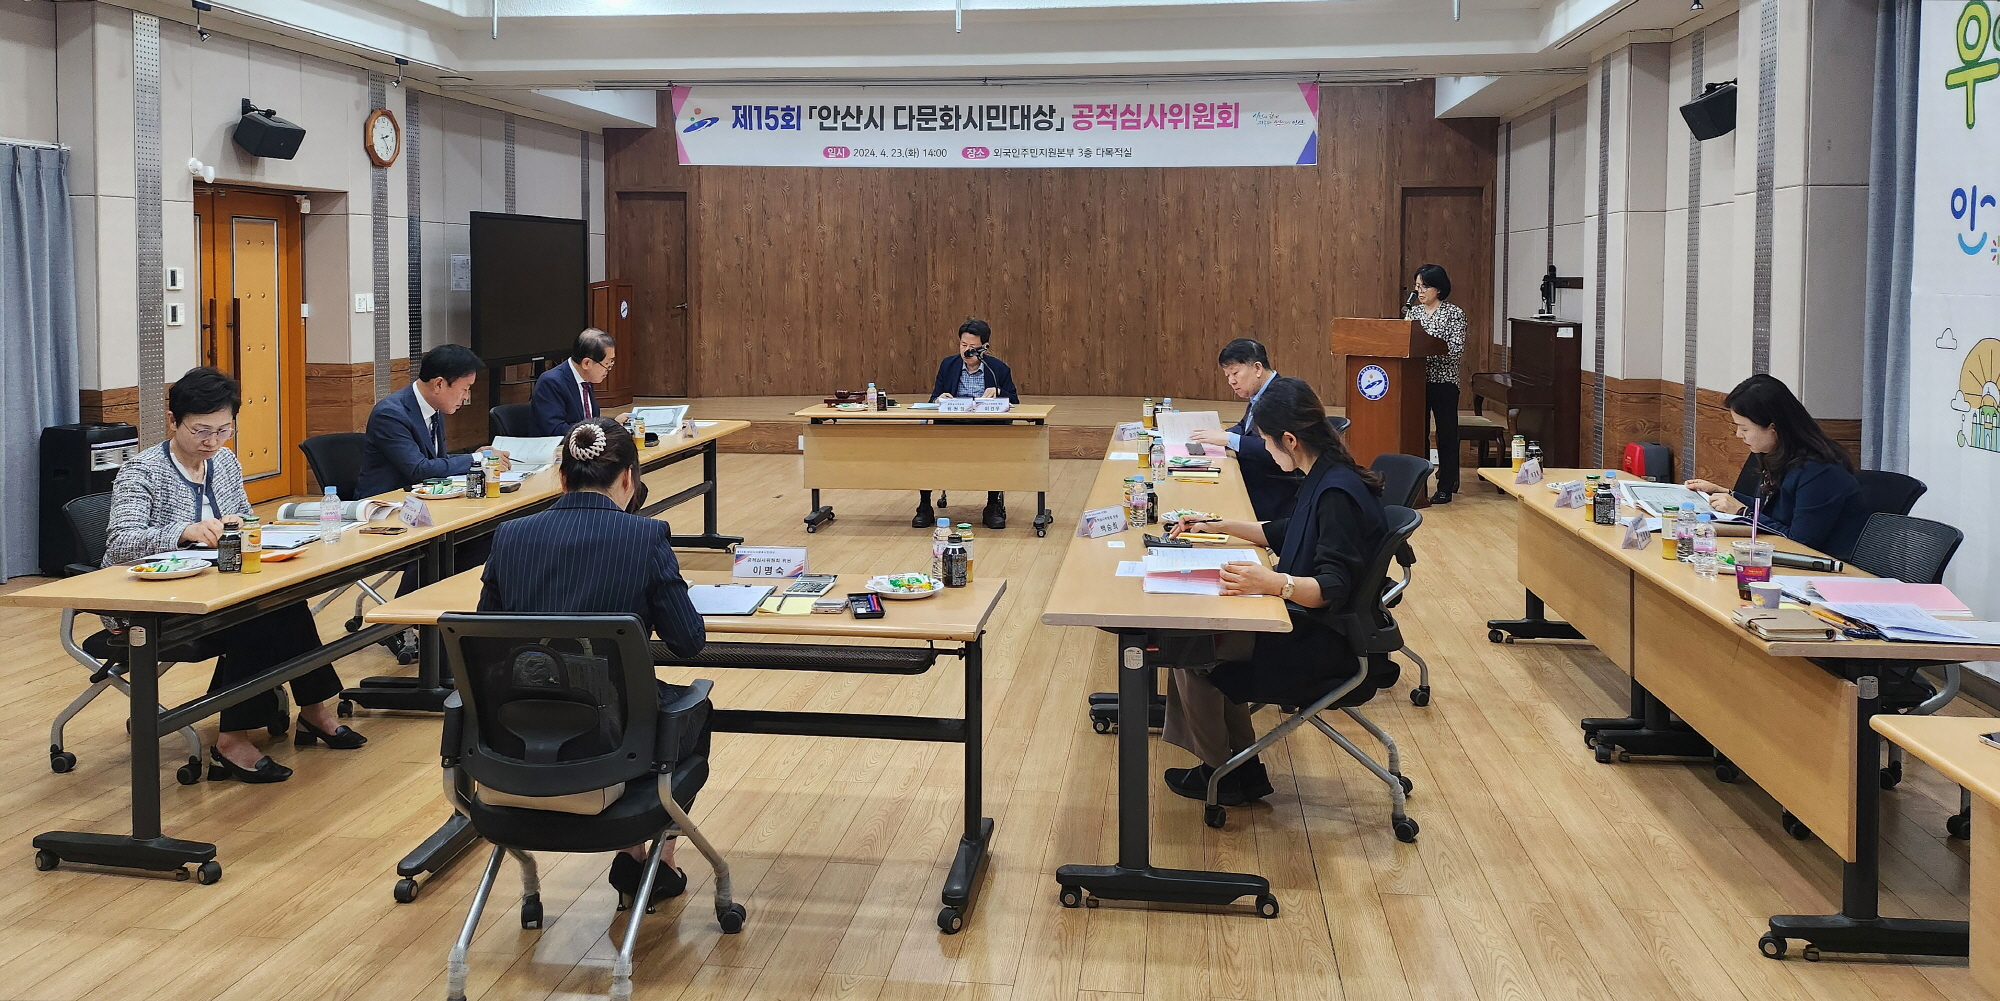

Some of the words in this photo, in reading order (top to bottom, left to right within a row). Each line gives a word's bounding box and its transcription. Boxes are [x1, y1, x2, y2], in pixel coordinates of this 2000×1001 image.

[1945, 0, 2000, 130] 우
[731, 104, 802, 131] 제15회
[1071, 102, 1240, 131] 공적심사위원회
[827, 147, 846, 158] 일시
[853, 148, 878, 158] 2024.
[922, 148, 947, 158] 14:00
[966, 148, 985, 159] 장소
[993, 147, 1075, 159] 외국인주민지원본부
[1078, 147, 1093, 158] 3층
[1096, 146, 1132, 158] 다목적실
[753, 565, 784, 575] 이명숙
